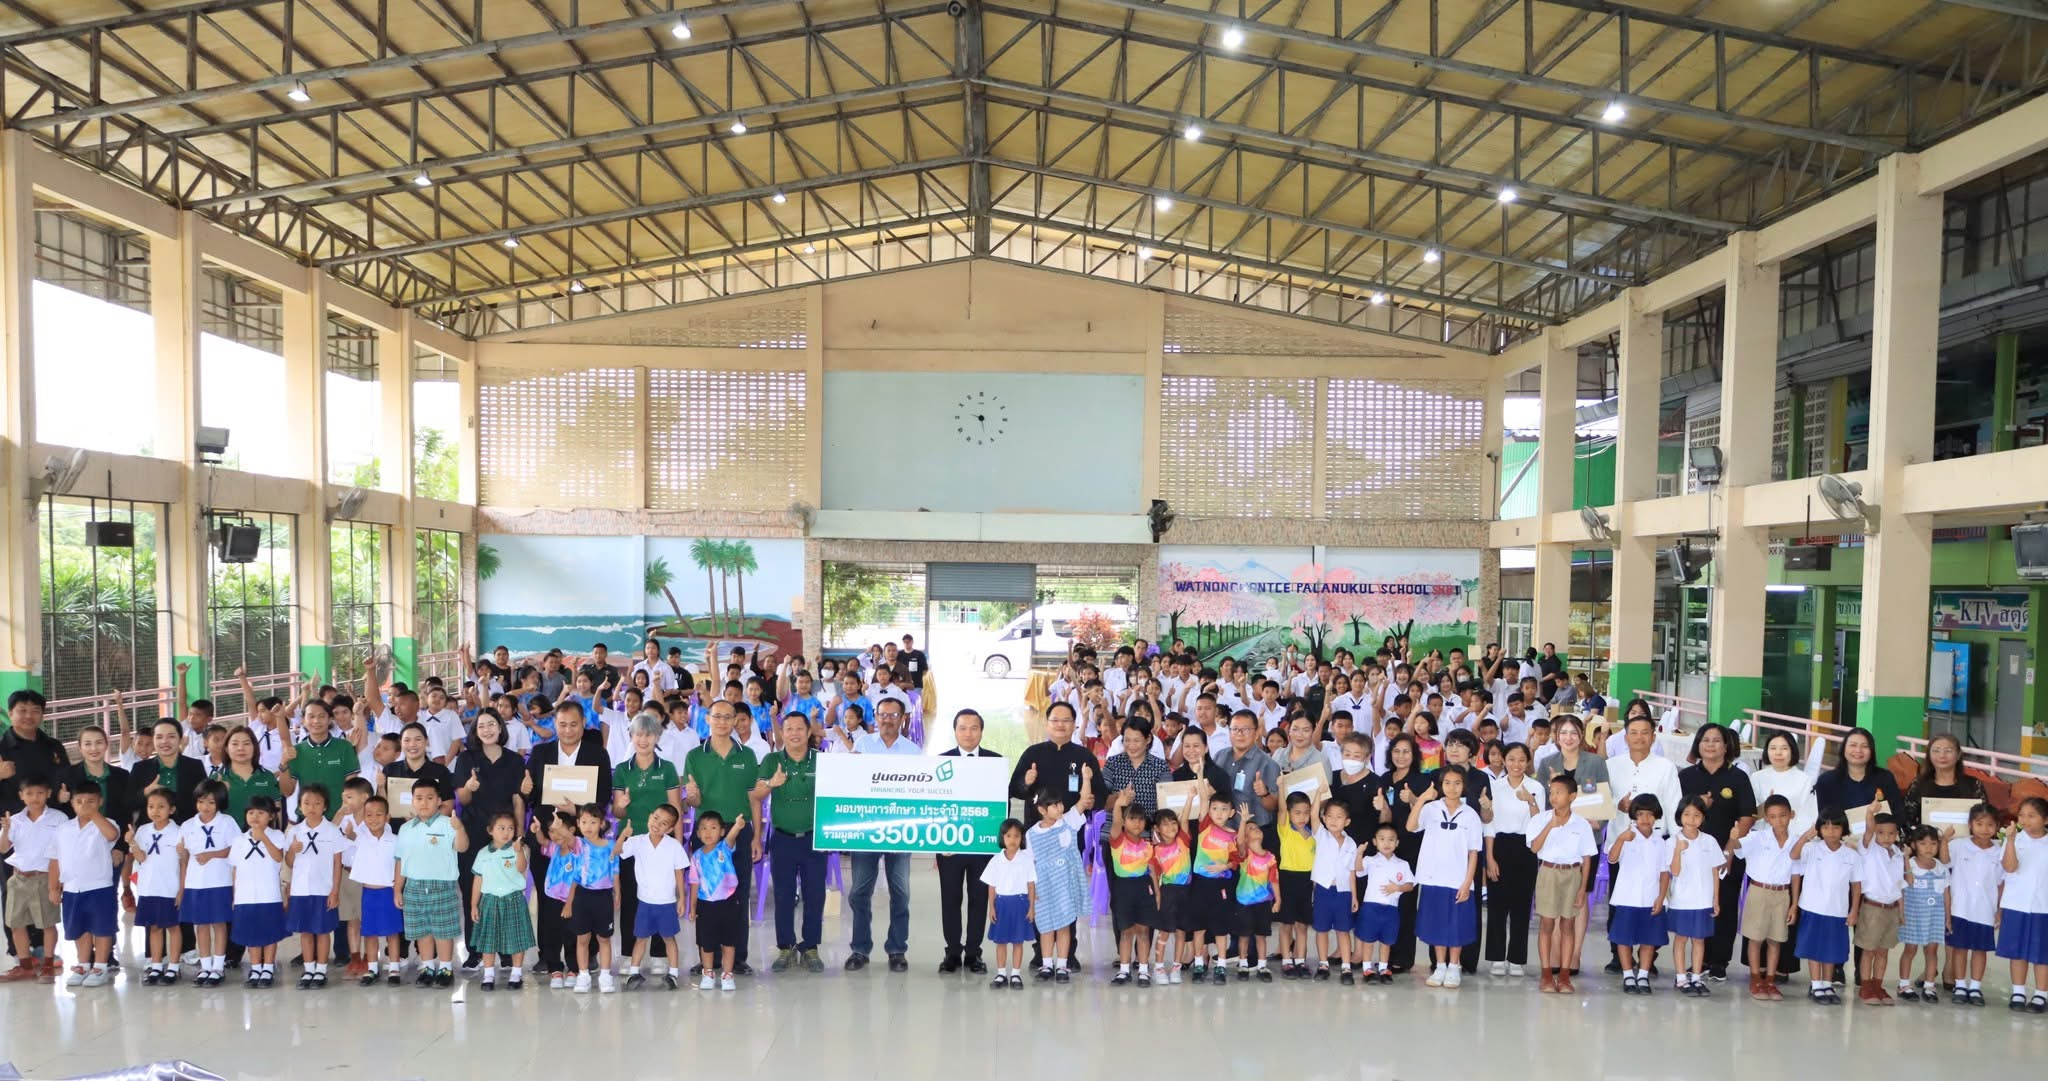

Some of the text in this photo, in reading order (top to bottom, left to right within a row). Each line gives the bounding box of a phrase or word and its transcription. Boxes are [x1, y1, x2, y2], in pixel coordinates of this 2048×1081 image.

[1296, 582, 1375, 594] PALANUKUL
[1380, 583, 1429, 595] SCHOOL
[1960, 600, 1997, 622] KTV
[871, 772, 933, 784] ปูนดอกบัว
[835, 802, 916, 818] มอบทุนการศึกษา
[920, 803, 958, 818] ประจำปี
[869, 822, 975, 847] 350,000
[979, 835, 997, 844] บาท
